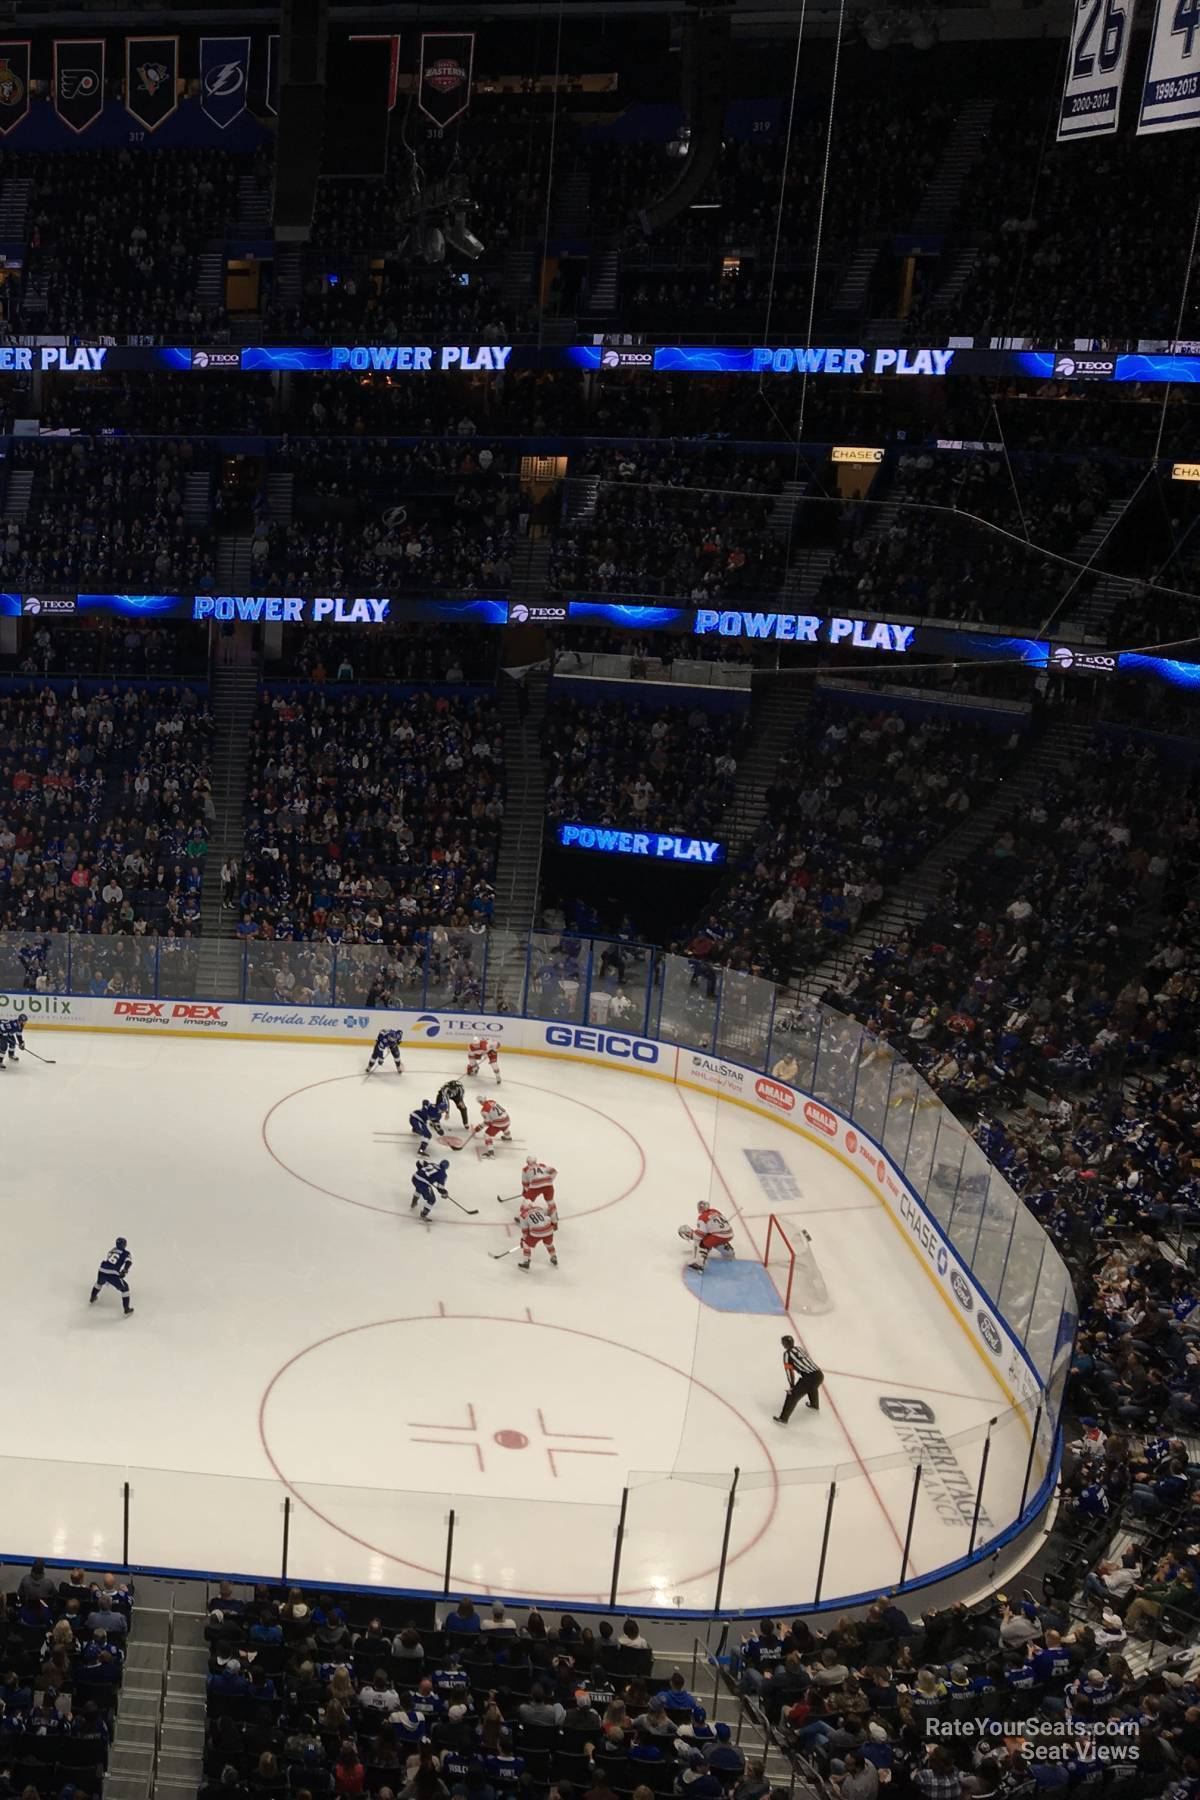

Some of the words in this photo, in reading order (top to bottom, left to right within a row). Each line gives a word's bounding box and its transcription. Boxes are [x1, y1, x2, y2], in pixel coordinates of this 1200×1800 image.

[1155, 77, 1198, 100] 1998-2013
[1071, 92, 1111, 113] 2000-2014
[752, 121, 770, 132] 319
[129, 132, 145, 142] 317
[41, 347, 107, 371] PLAY
[209, 354, 239, 362] TECO
[331, 347, 432, 370] POWER
[441, 347, 512, 370] PLAY
[620, 353, 653, 362] TECO
[752, 348, 864, 373] POWER
[875, 349, 956, 375] PLAY
[1075, 361, 1113, 370] TECO
[832, 450, 875, 460] CHASE
[41, 600, 76, 609] TECO
[194, 596, 303, 623] POWER
[314, 597, 391, 623] PLAY
[528, 608, 566, 617] TECO
[695, 609, 823, 642] POWER
[830, 617, 916, 652] PLAY
[1074, 653, 1116, 667] TECO
[562, 825, 648, 855] POWER
[656, 837, 720, 862] PLAY
[114, 1001, 166, 1017] DEX
[172, 1004, 224, 1019] DEX
[126, 1015, 170, 1025] imaging
[183, 1018, 228, 1027] imaging
[251, 1012, 305, 1026] Florida
[308, 1014, 339, 1027] Blue
[444, 1019, 504, 1032] TECO
[545, 1026, 659, 1064] GEICO
[757, 1082, 793, 1105] AMALIE
[806, 1105, 837, 1131] AMALIE
[899, 1192, 938, 1259] CHASE
[952, 1275, 972, 1307] Ford
[979, 1318, 999, 1351] Ford
[913, 1426, 995, 1528] HERITAGE
